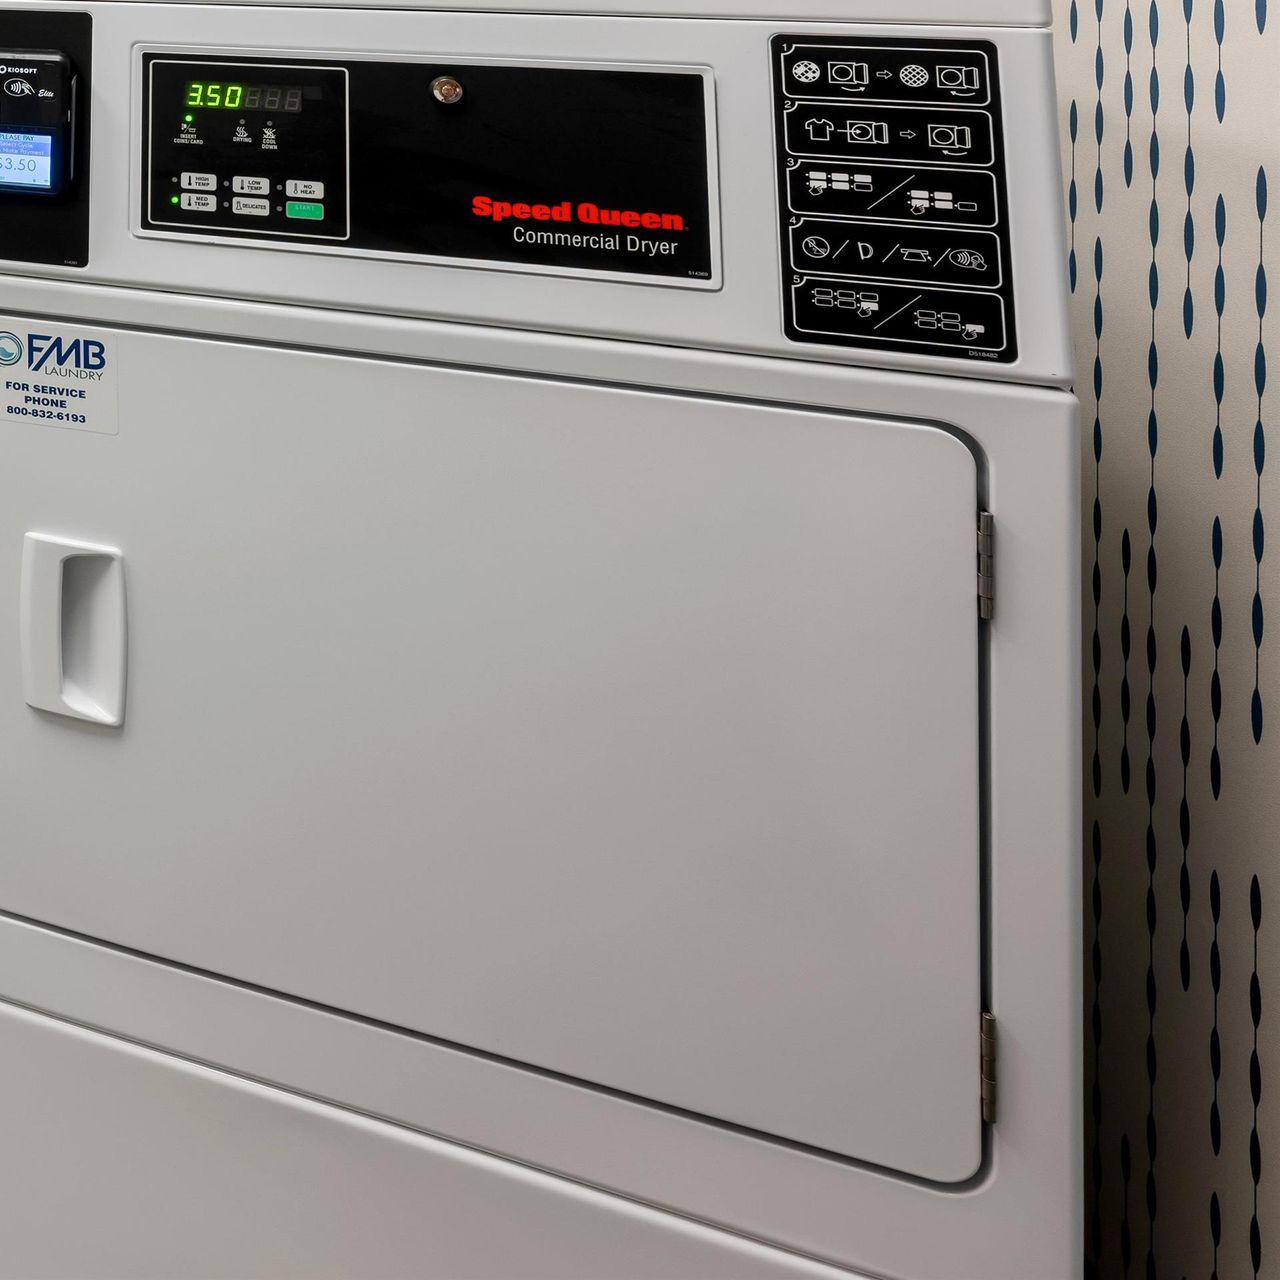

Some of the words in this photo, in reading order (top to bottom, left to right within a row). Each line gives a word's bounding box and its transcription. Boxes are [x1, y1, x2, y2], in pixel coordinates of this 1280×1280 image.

[782, 43, 788, 52] 1
[188, 84, 242, 107] 3.50
[784, 100, 792, 108] 2
[787, 158, 794, 166] 3
[242, 203, 267, 211] DELICATES
[471, 196, 571, 222] Speed
[577, 202, 684, 231] Queen
[789, 216, 797, 224] 4
[513, 226, 620, 251] Commercial
[626, 235, 679, 257] Dryer
[793, 275, 801, 283] 5
[27, 333, 106, 371] FMB
[44, 365, 104, 381] LAUNDRY
[5, 381, 29, 392] FOR
[33, 384, 87, 399] SERVICE
[24, 396, 67, 409] PHONE
[6, 405, 86, 424] 800-832-6193
